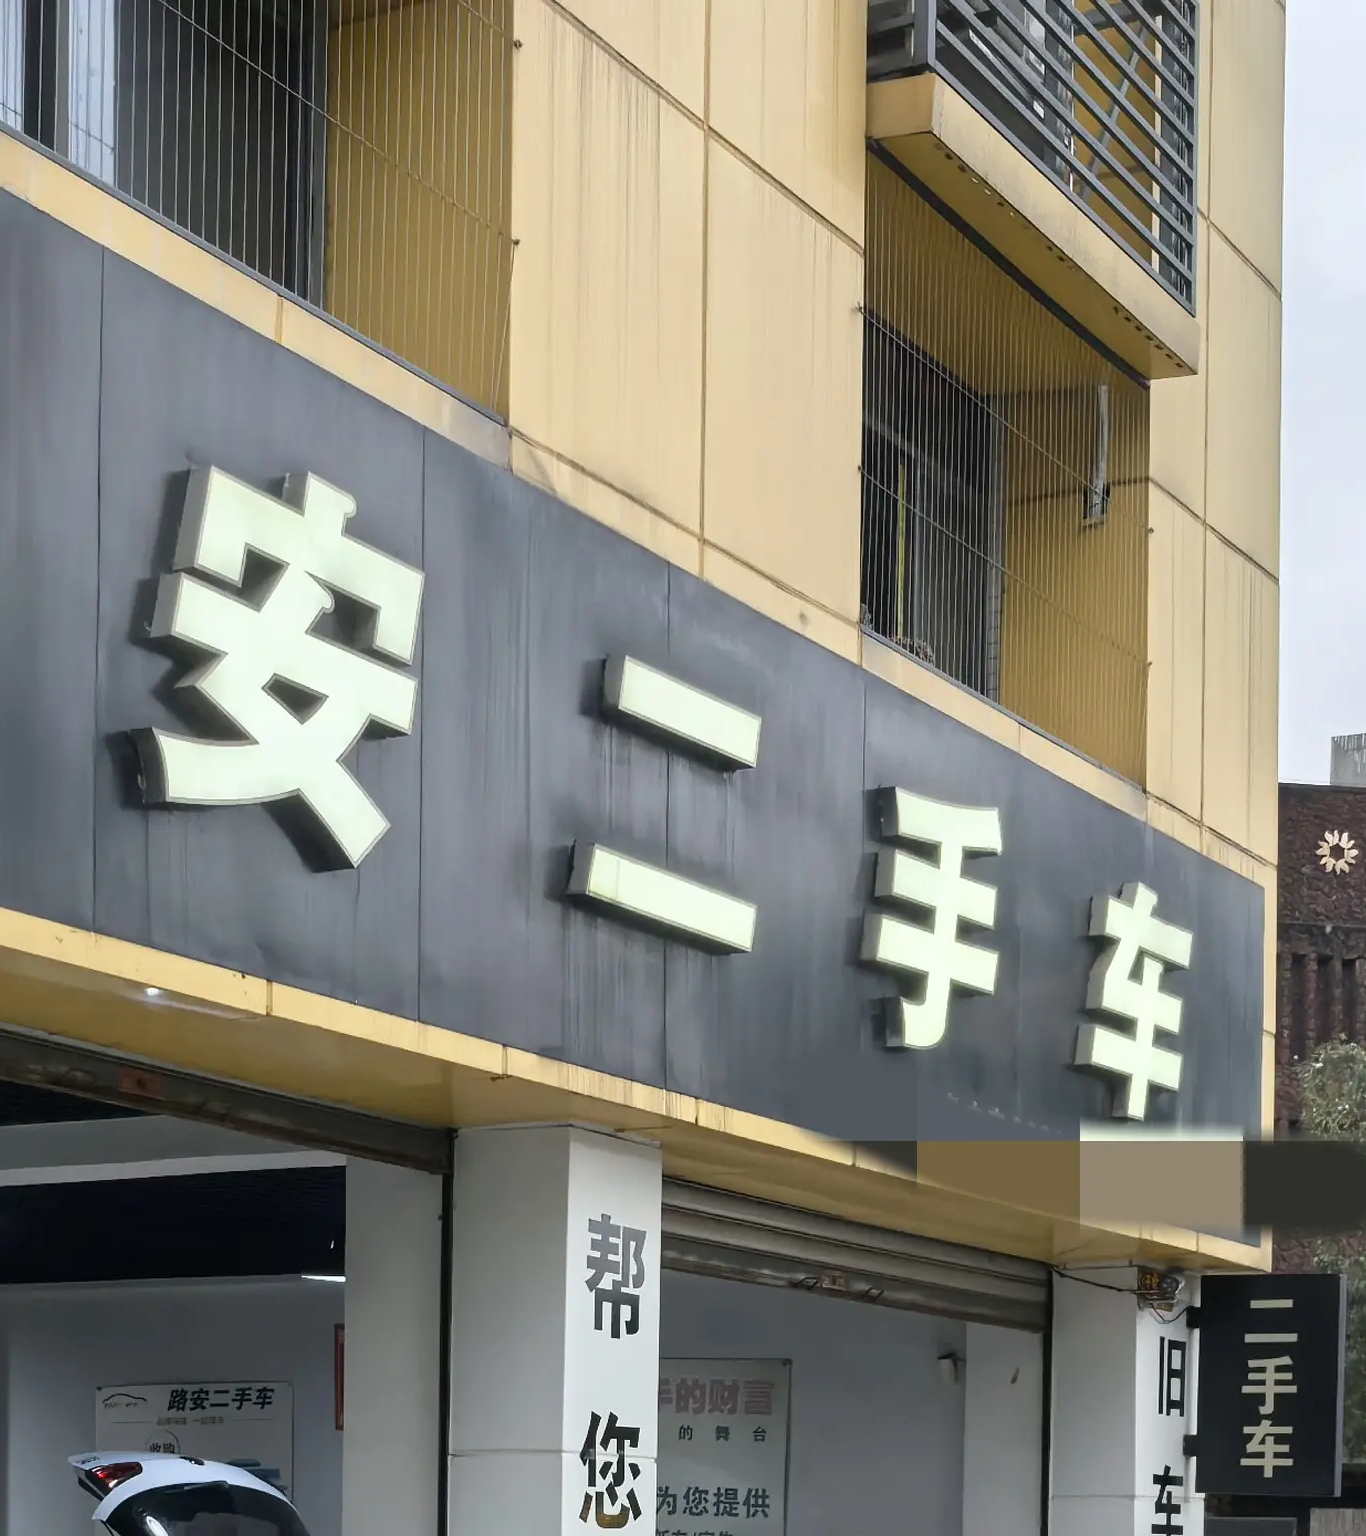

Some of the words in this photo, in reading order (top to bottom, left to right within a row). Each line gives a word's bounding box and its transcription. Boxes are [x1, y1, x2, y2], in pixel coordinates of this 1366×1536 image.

[167, 1386, 275, 1412] 路安二手车
[1240, 1299, 1299, 1479] 二手车
[656, 1485, 770, 1519] 为您提供
